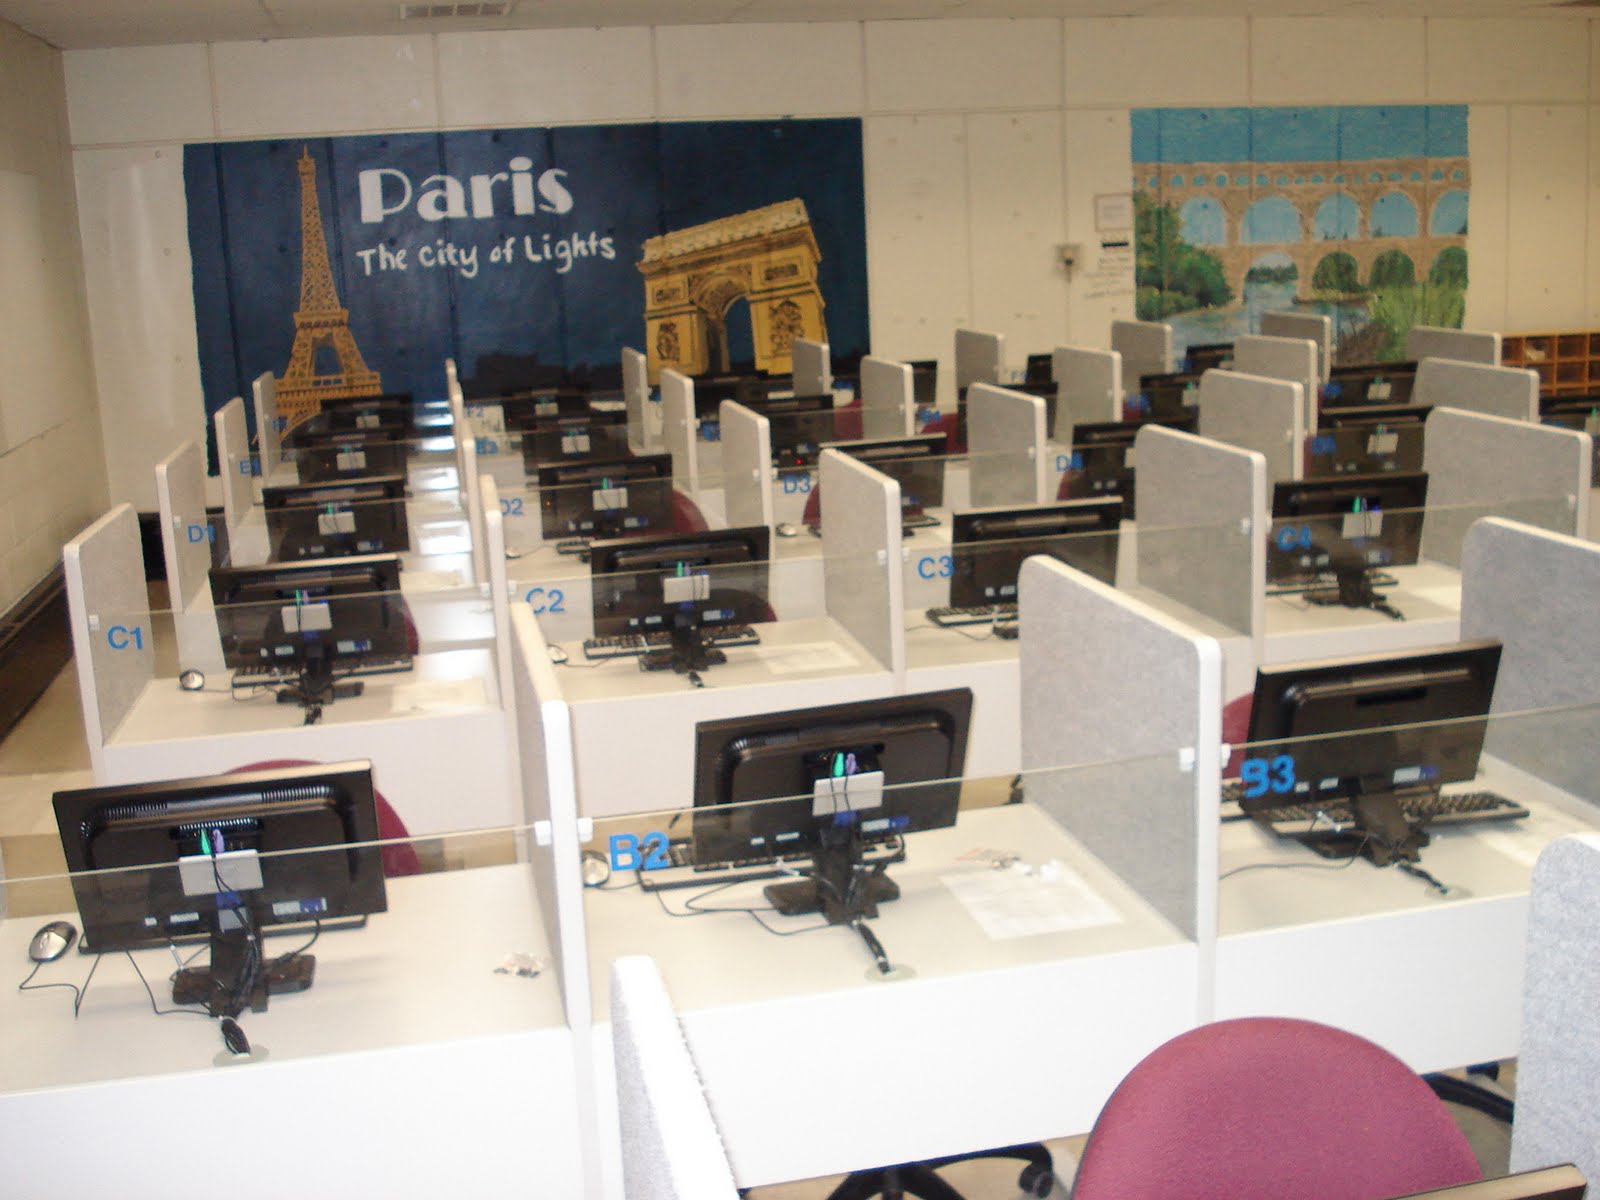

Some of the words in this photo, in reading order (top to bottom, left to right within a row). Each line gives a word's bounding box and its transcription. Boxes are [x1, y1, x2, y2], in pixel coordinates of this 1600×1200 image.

[358, 156, 574, 224] Paris
[356, 243, 408, 277] The
[489, 236, 516, 264] of
[524, 231, 617, 274] Lights
[783, 474, 812, 494] D3
[187, 523, 216, 544] D1
[1277, 526, 1312, 551] C4
[917, 555, 955, 579] C3
[525, 587, 566, 614] C2
[107, 625, 143, 650] C1
[609, 832, 670, 871] B2
